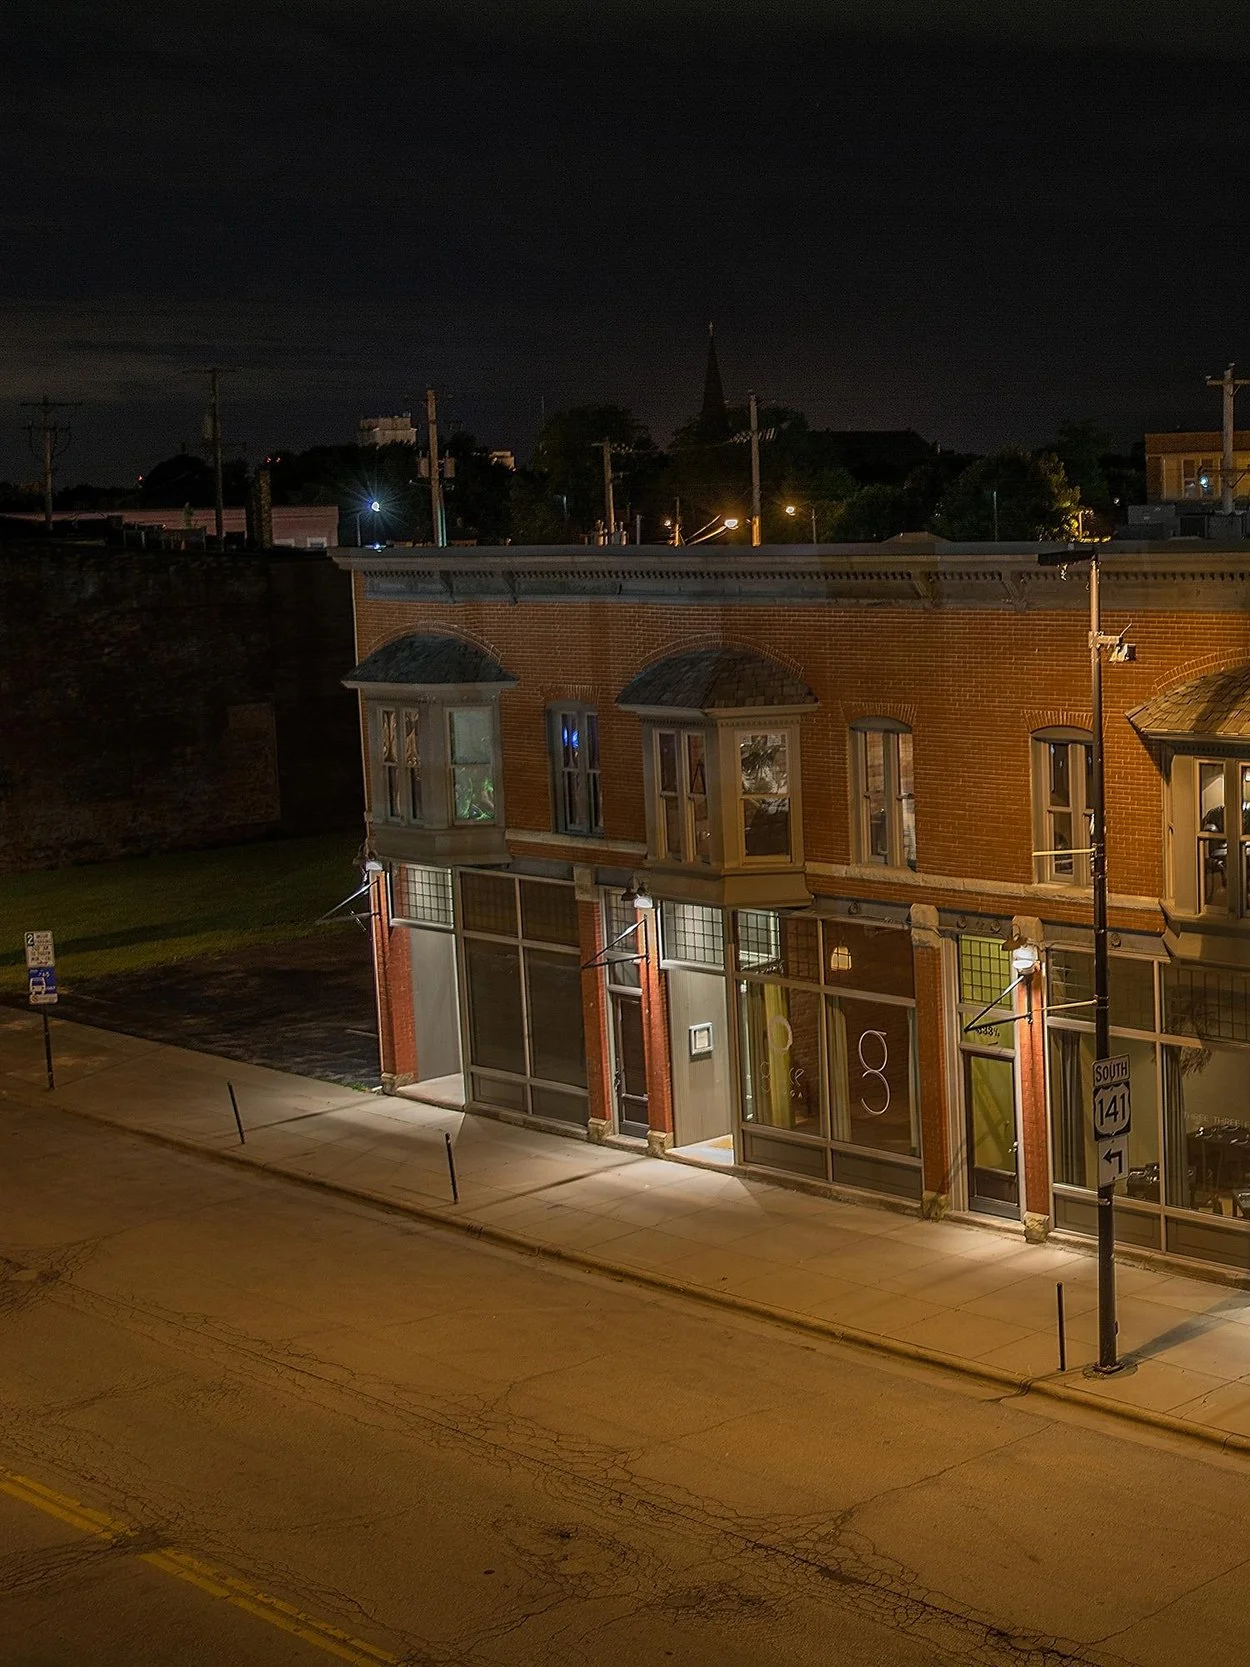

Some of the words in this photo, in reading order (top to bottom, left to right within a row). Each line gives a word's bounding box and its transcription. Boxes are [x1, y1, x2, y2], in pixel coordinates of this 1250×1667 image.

[26, 934, 34, 945] 2
[1095, 1061, 1128, 1083] SOUTH
[1097, 1092, 1126, 1127] 141
